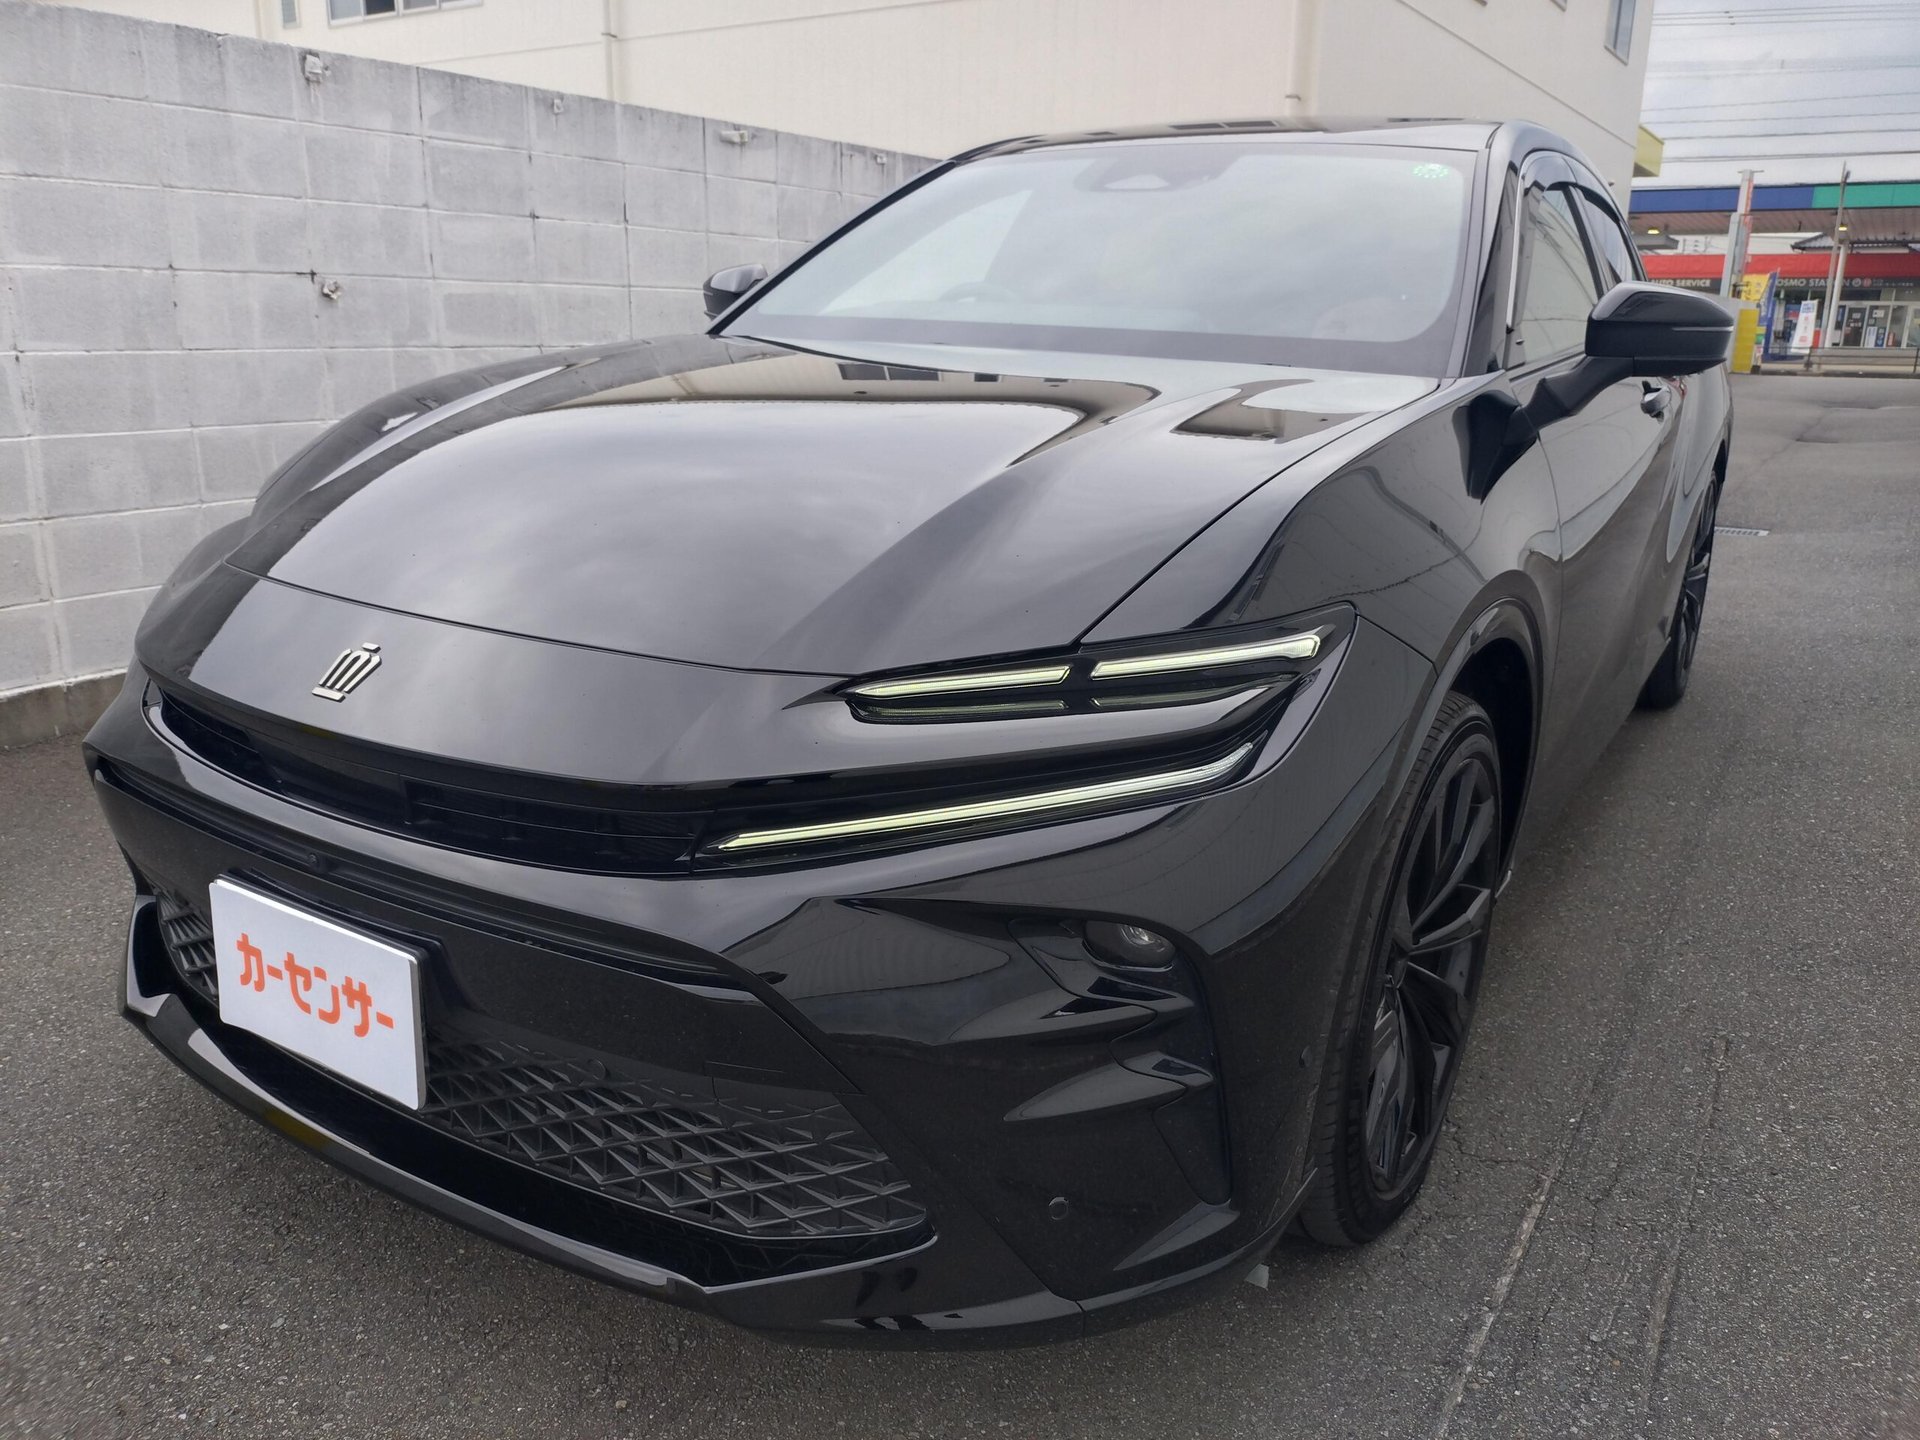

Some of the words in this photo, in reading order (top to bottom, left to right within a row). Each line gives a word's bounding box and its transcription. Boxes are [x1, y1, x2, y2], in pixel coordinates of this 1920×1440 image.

[1676, 279, 1711, 287] SERVICE
[1776, 278, 1807, 287] OSMO
[1808, 278, 1850, 287] STAN
[237, 932, 394, 1038] カーセンサー
